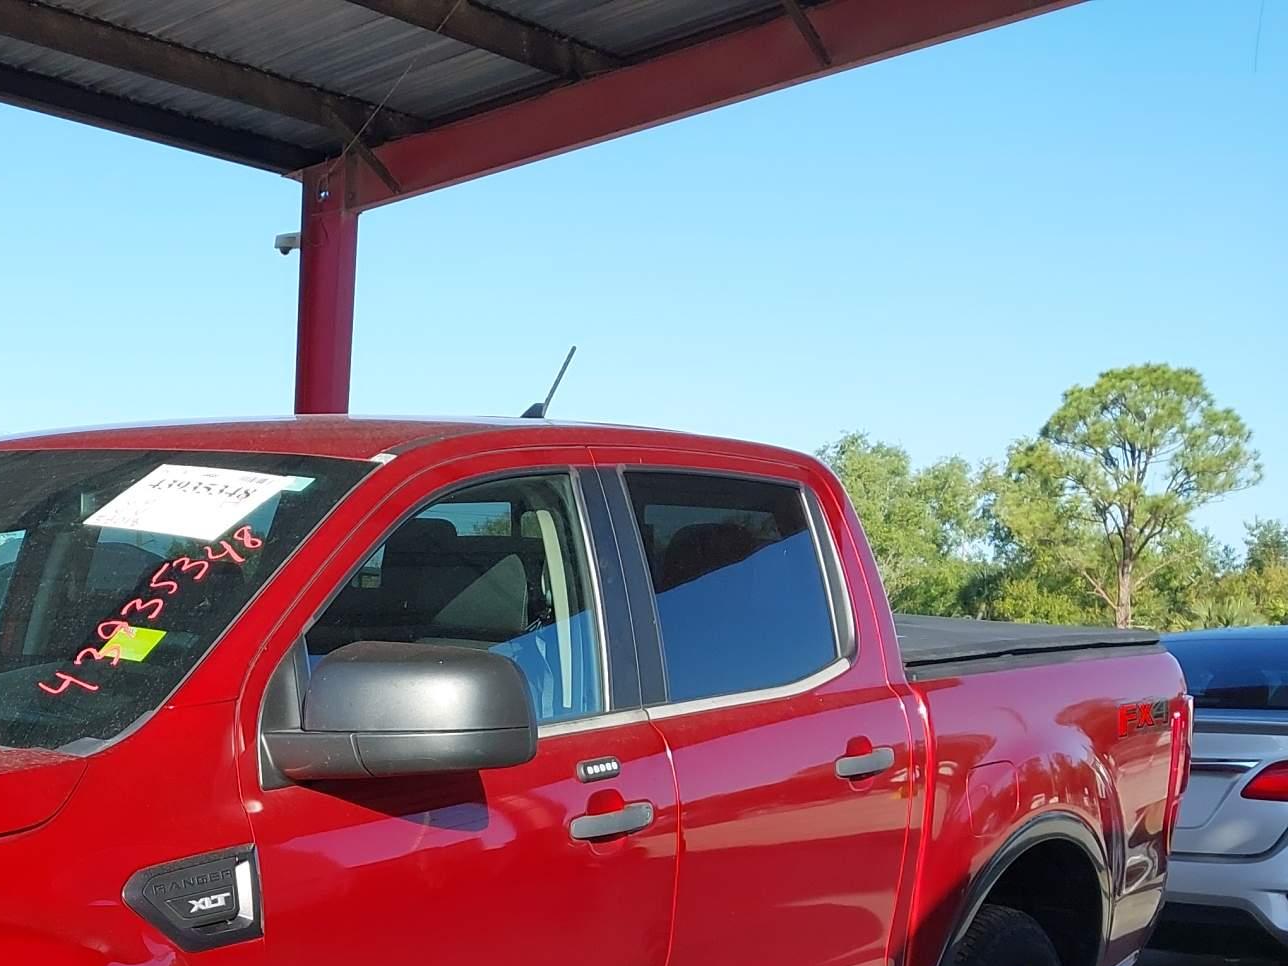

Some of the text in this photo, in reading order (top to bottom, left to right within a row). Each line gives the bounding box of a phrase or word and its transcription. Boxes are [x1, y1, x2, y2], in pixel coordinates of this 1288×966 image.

[37, 525, 263, 694] 43935348
[1117, 699, 1170, 738] FX4
[152, 869, 233, 897] RANGER
[187, 892, 231, 913] XLT
